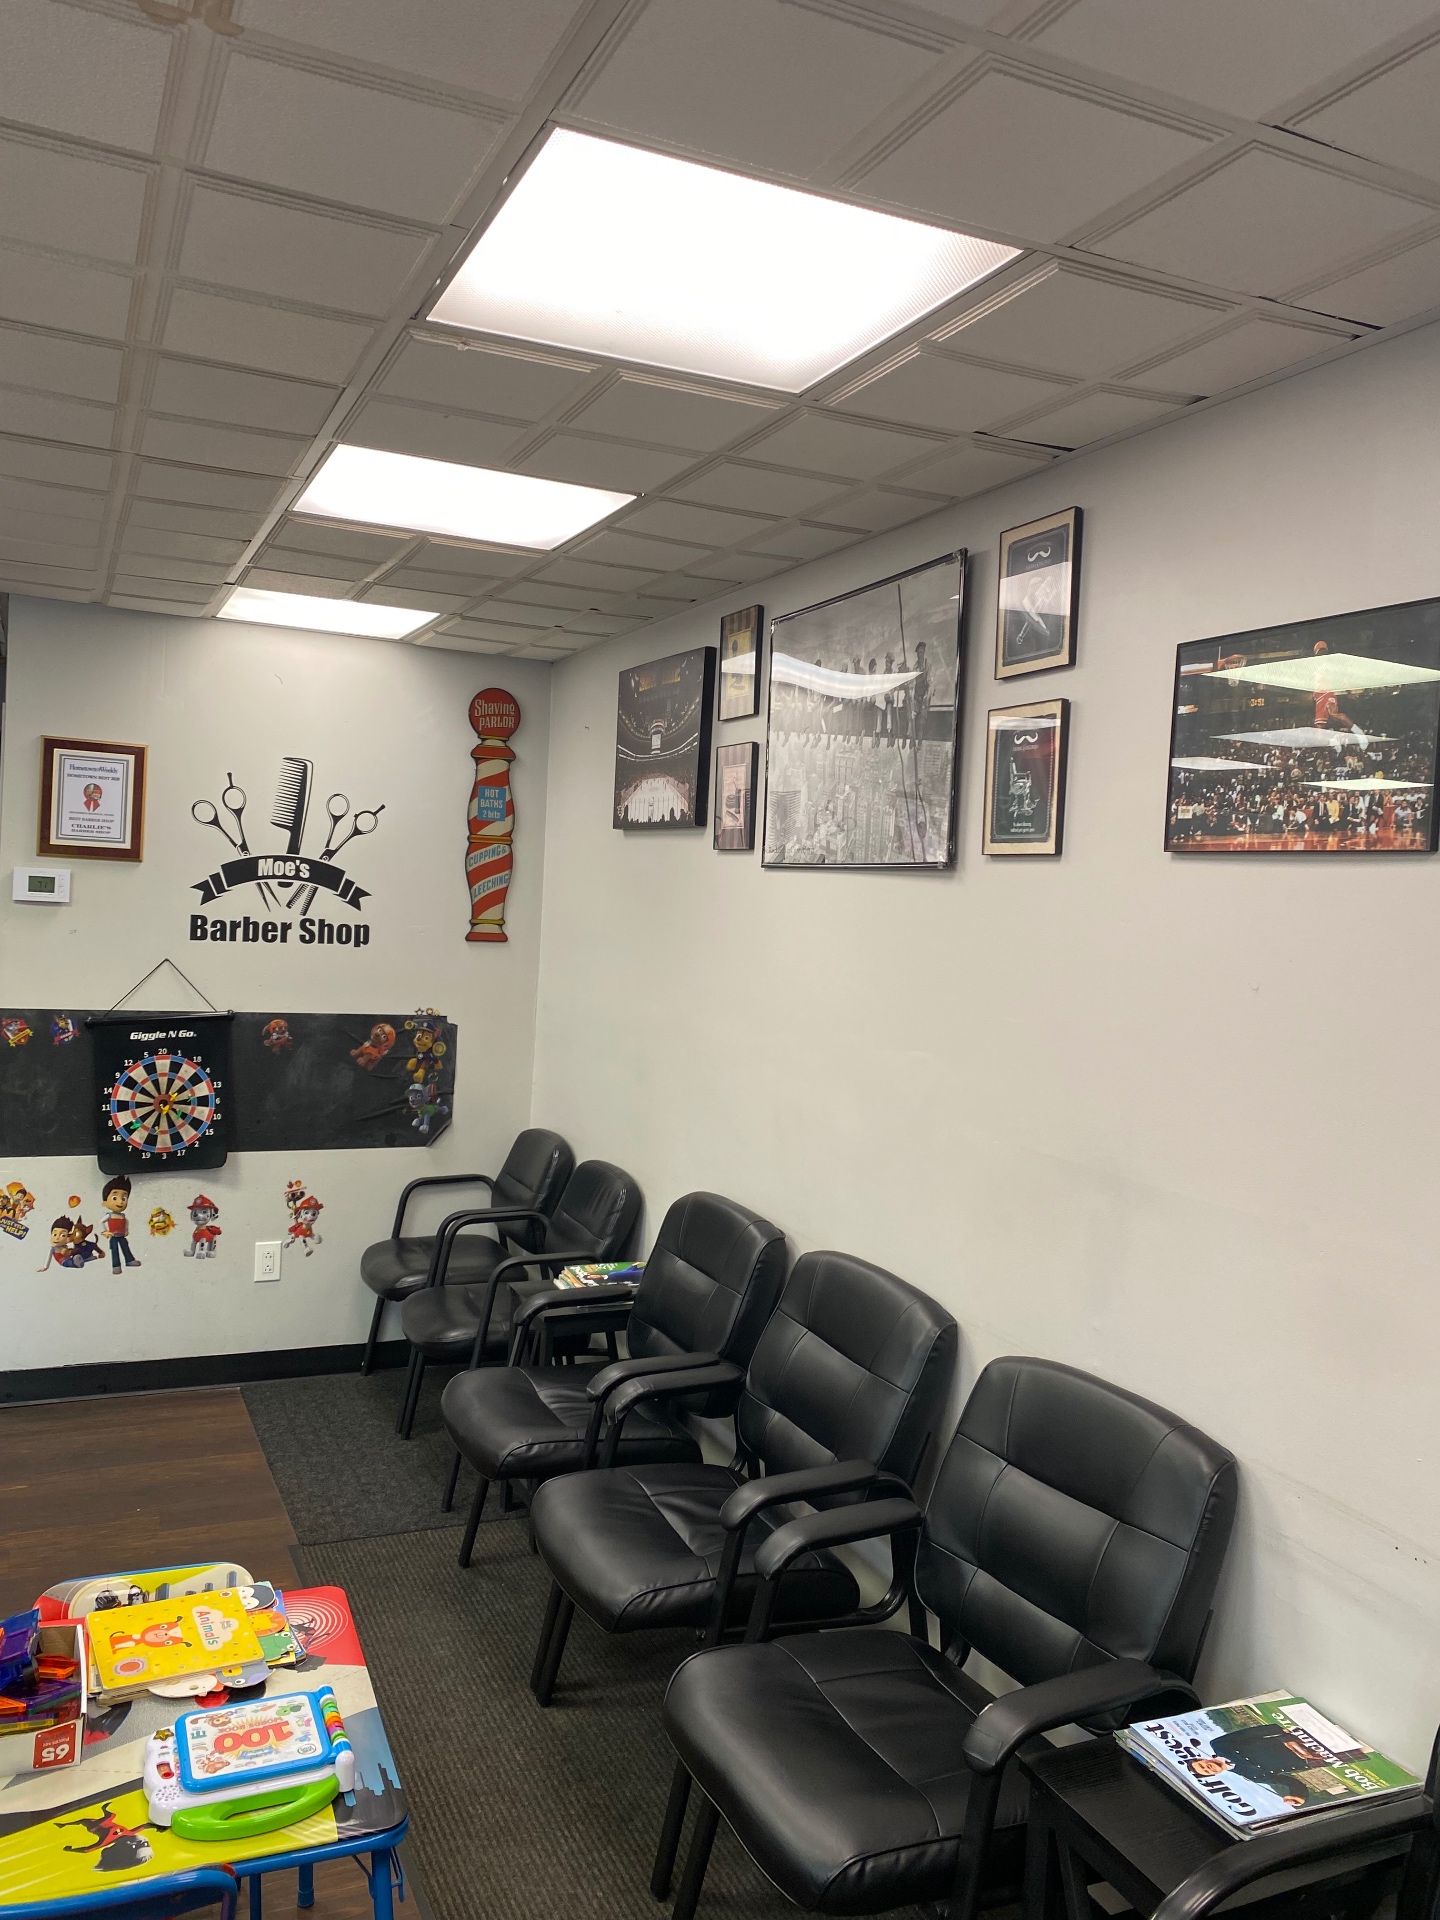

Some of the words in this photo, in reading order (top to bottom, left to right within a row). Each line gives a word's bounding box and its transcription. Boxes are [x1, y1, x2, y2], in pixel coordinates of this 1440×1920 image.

[474, 699, 515, 717] Shaving
[478, 716, 515, 731] PARLOR
[480, 798, 503, 809] BATHS
[484, 788, 500, 799] HOT
[482, 809, 487, 818] 2
[488, 809, 501, 819] bits
[468, 844, 501, 868] CUPPING
[257, 858, 311, 878] Moe's
[473, 872, 509, 899] LEECHING
[189, 914, 292, 943] Barber
[299, 918, 370, 947] Shop
[130, 1031, 167, 1041] Giggle
[167, 1030, 178, 1038] N
[6, 1225, 27, 1238] HELP!
[195, 1611, 222, 1646] Animals
[217, 1722, 246, 1735] BOOK
[249, 1715, 284, 1729] WORDS
[213, 1721, 294, 1753] 100
[1271, 1712, 1350, 1769] MacIntyre
[41, 1743, 70, 1763] 65
[1344, 1768, 1381, 1791] Bob
[1197, 1780, 1257, 1817] Golf
